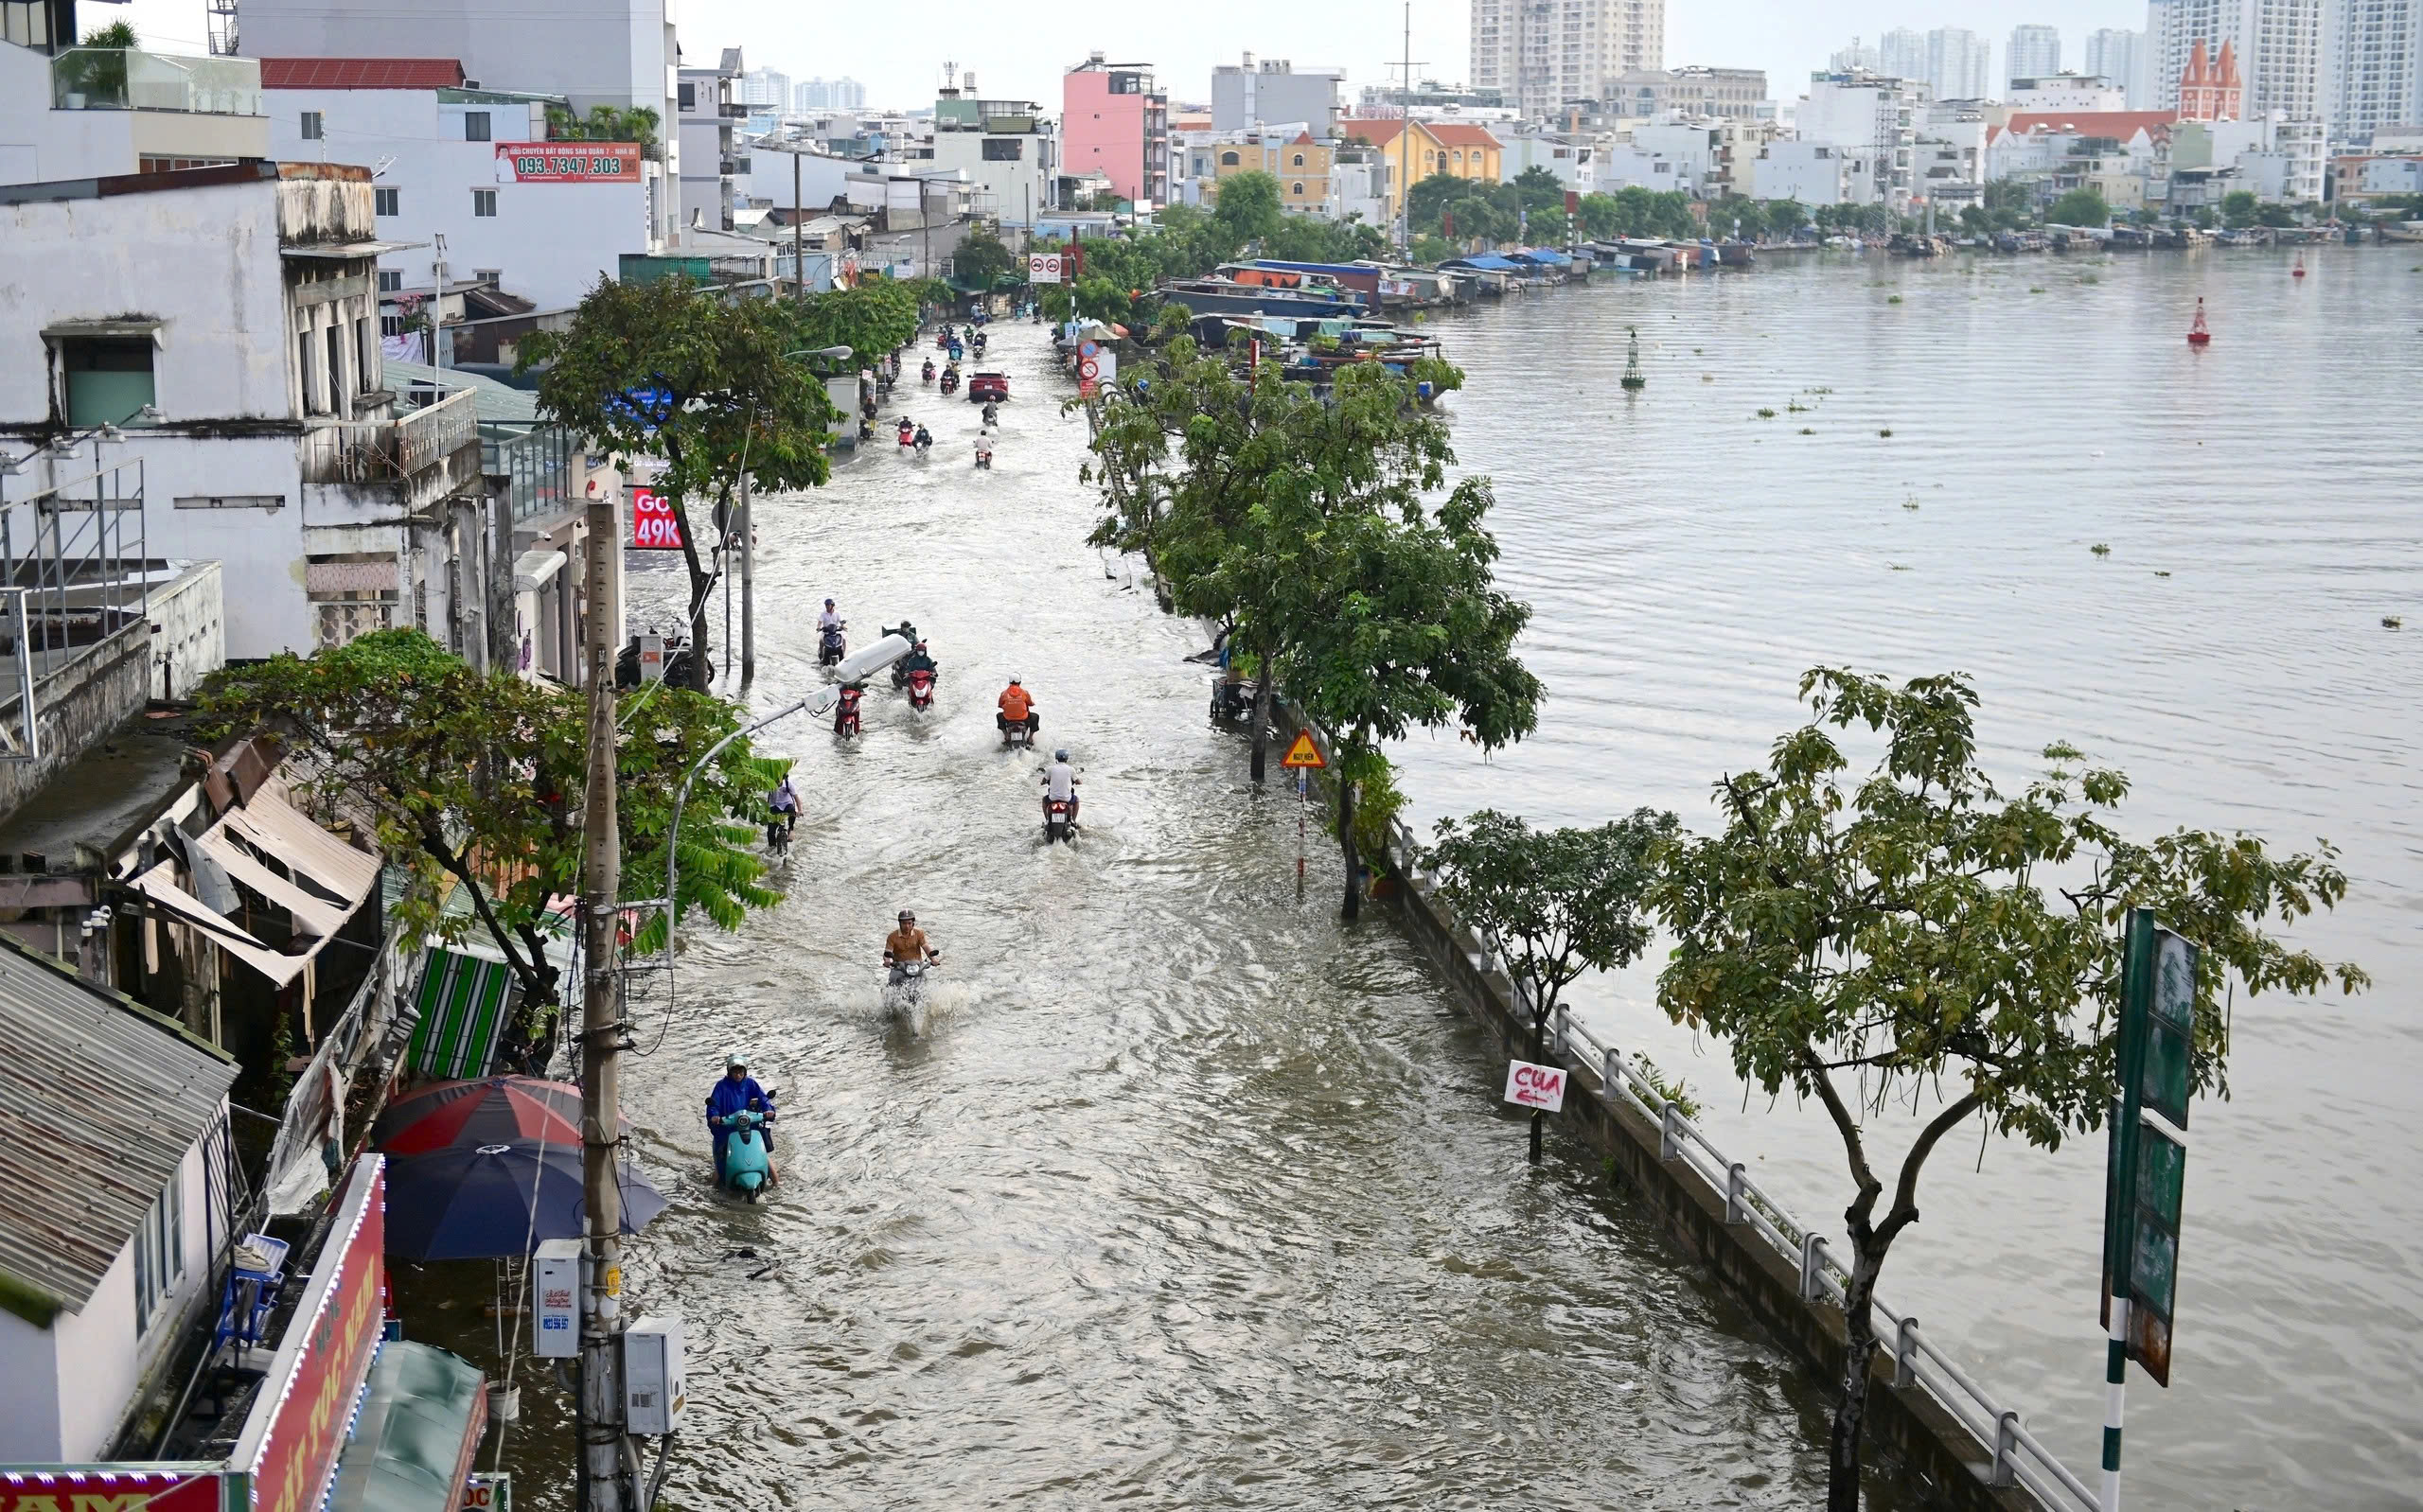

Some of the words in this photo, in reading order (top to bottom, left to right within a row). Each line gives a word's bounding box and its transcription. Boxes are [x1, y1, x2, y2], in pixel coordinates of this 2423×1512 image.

[517, 156, 621, 175] 093.7347.303
[637, 494, 670, 516] GỌ
[637, 518, 682, 546] 49K
[345, 1253, 375, 1369] NAM
[0, 1493, 152, 1512] AM
